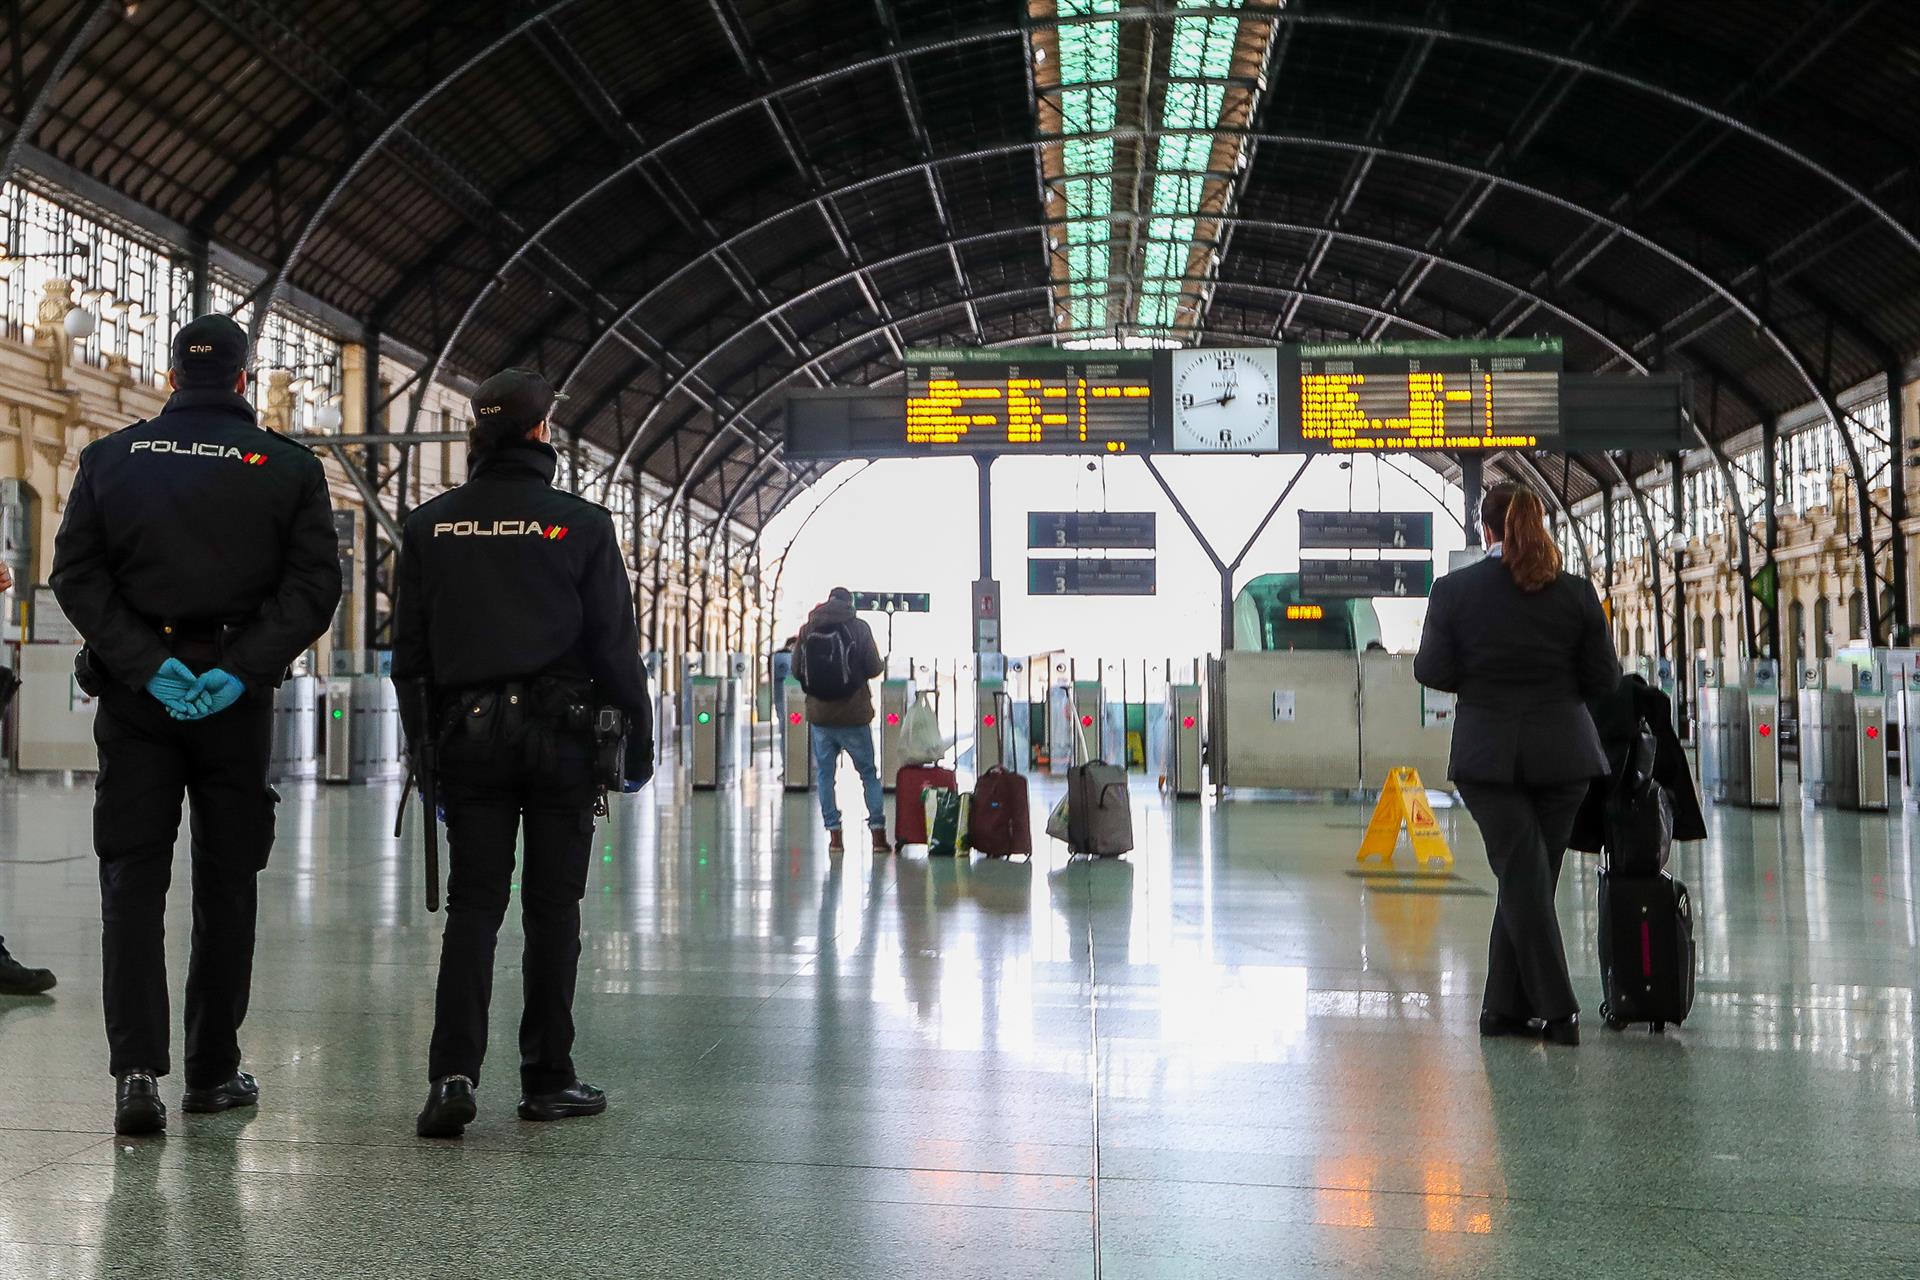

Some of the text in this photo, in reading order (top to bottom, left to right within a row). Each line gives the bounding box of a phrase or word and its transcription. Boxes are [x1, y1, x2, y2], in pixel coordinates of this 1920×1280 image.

[189, 345, 213, 353] CNP
[1217, 357, 1235, 370] 12
[1182, 393, 1194, 410] 9
[1257, 392, 1270, 406] 3
[480, 405, 502, 415] CNP
[1219, 429, 1232, 442] 6
[130, 440, 243, 460] POLICIA
[434, 520, 545, 539] POLICIA
[1056, 530, 1067, 546] 3
[1056, 577, 1067, 593] 3
